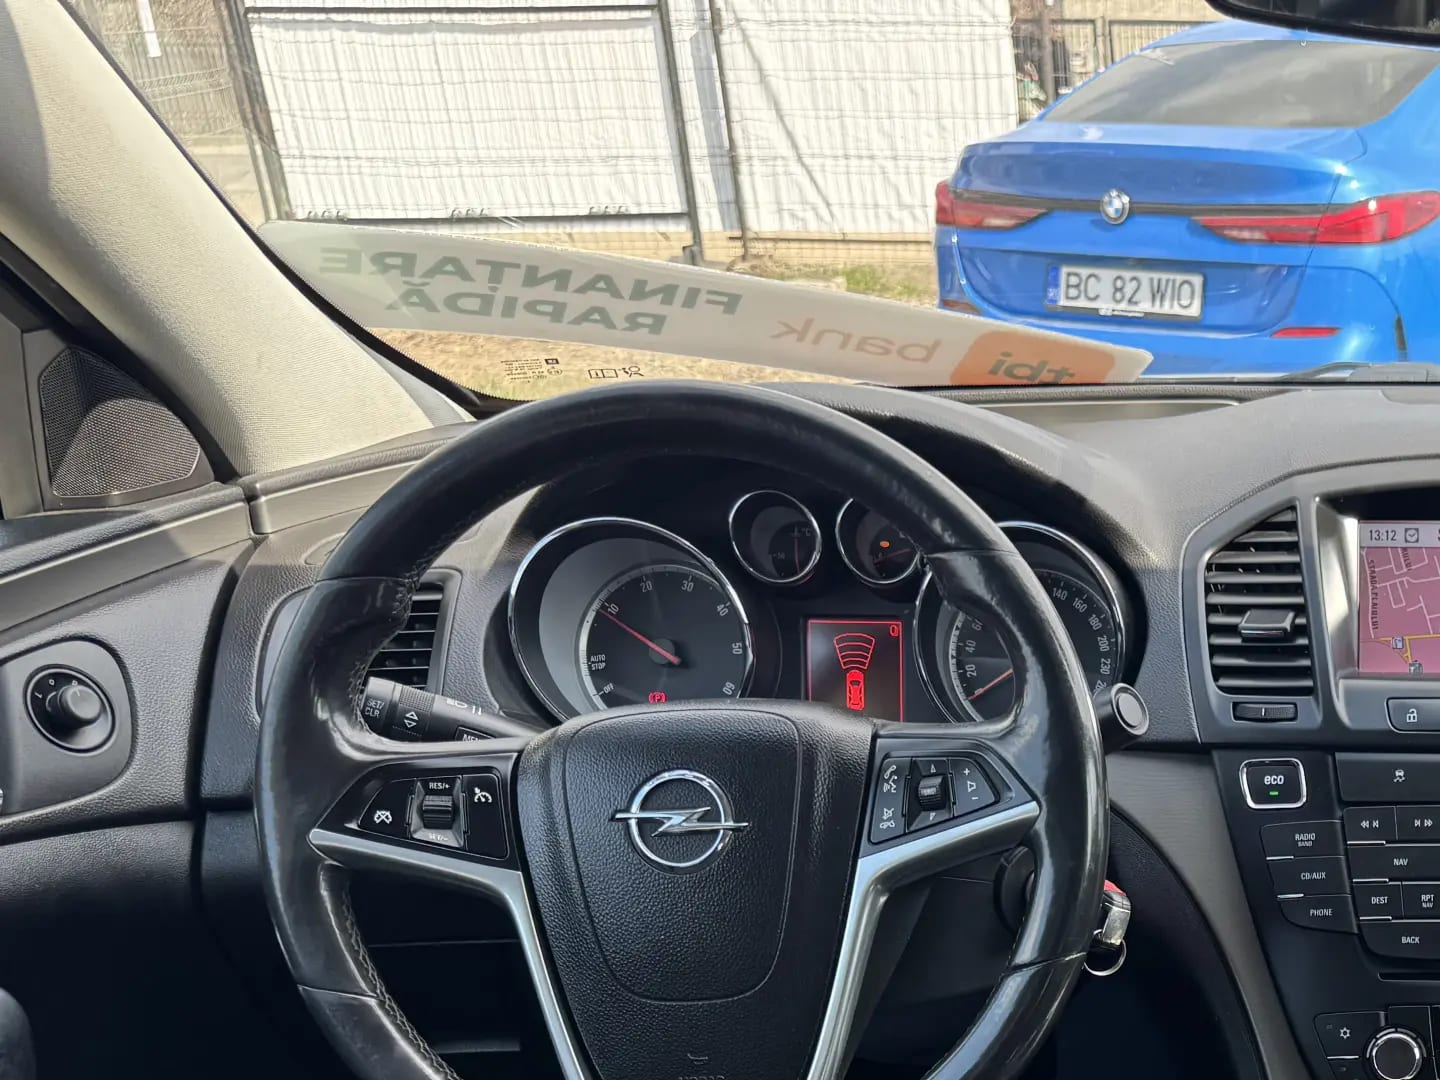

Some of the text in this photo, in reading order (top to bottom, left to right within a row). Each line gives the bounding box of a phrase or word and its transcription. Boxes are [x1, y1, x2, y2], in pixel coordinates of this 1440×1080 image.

[1065, 271, 1196, 309] BC 82 WIO
[1369, 529, 1397, 541] 13:12
[640, 581, 653, 593] 20
[681, 580, 694, 592] 30
[1052, 587, 1068, 600] 140
[607, 603, 619, 615] 10
[716, 603, 729, 617] 40
[1072, 598, 1088, 613] 160
[1088, 614, 1102, 631] 180
[732, 642, 742, 655] 50
[965, 639, 976, 653] 40
[1097, 635, 1110, 652] 200
[965, 664, 977, 678] 20
[1100, 658, 1110, 675] 230
[722, 681, 736, 696] 60
[366, 699, 385, 709] SET/
[365, 707, 380, 717] CLR
[1264, 775, 1284, 785] eco
[1295, 833, 1316, 841] RADIO
[1393, 858, 1408, 866] NAV
[1300, 871, 1326, 880] CD/AUX
[1371, 896, 1388, 904] DEST
[1421, 894, 1434, 902] RPT
[1310, 908, 1332, 917] PHONE
[1401, 936, 1420, 944] BACK
